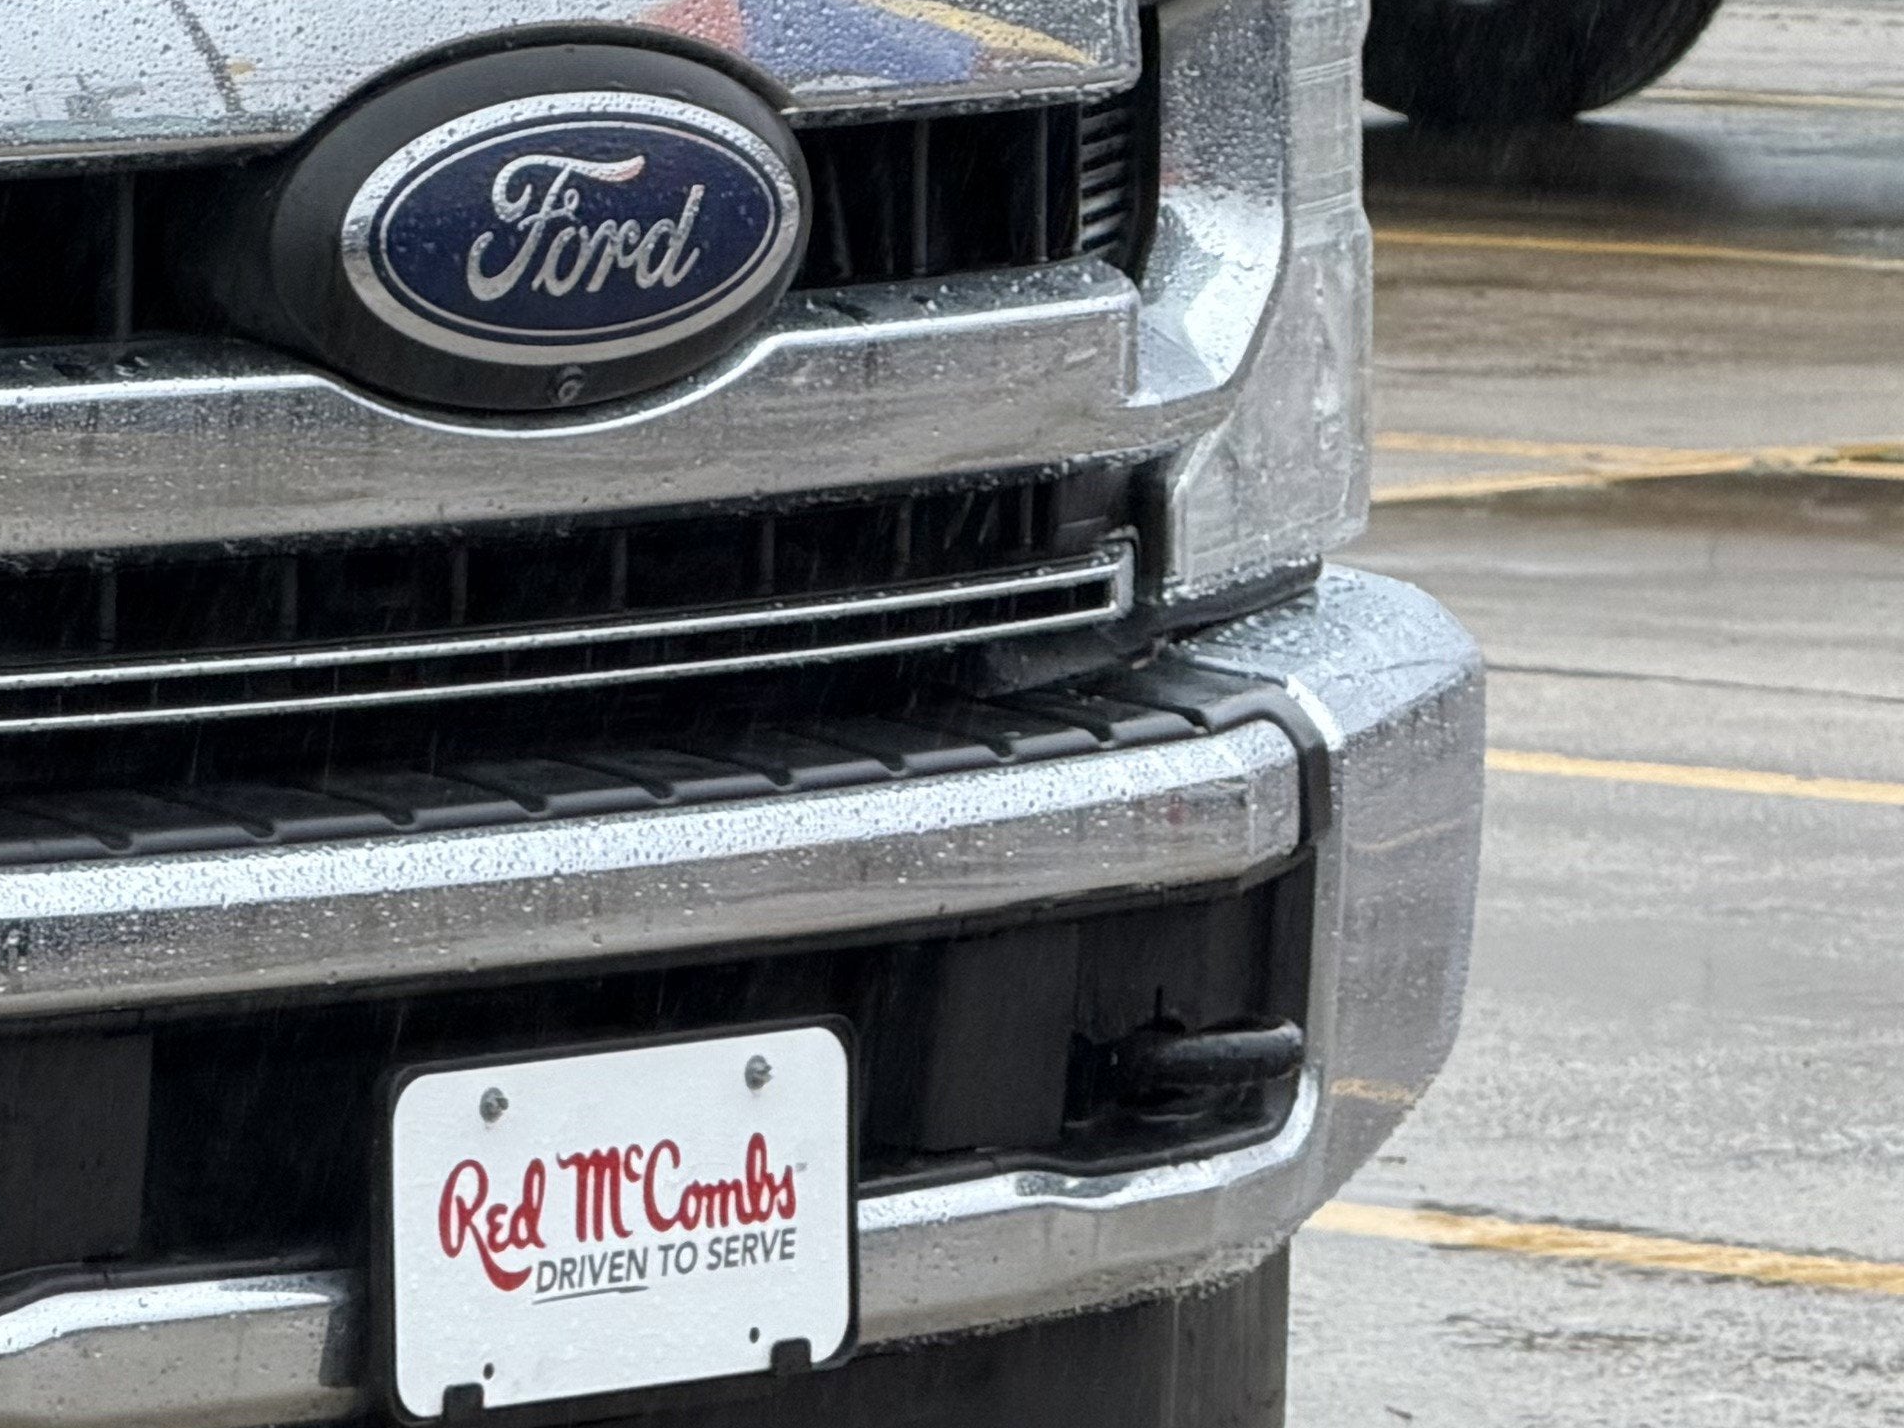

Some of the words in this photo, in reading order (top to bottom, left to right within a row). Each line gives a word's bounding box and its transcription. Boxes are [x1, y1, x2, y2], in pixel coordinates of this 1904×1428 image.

[467, 154, 705, 302] Ford
[438, 1158, 546, 1292] Red
[556, 1132, 798, 1243] McCombs
[534, 1246, 650, 1294] DRIVEN
[657, 1240, 699, 1277] TO
[706, 1226, 798, 1271] SERVE
